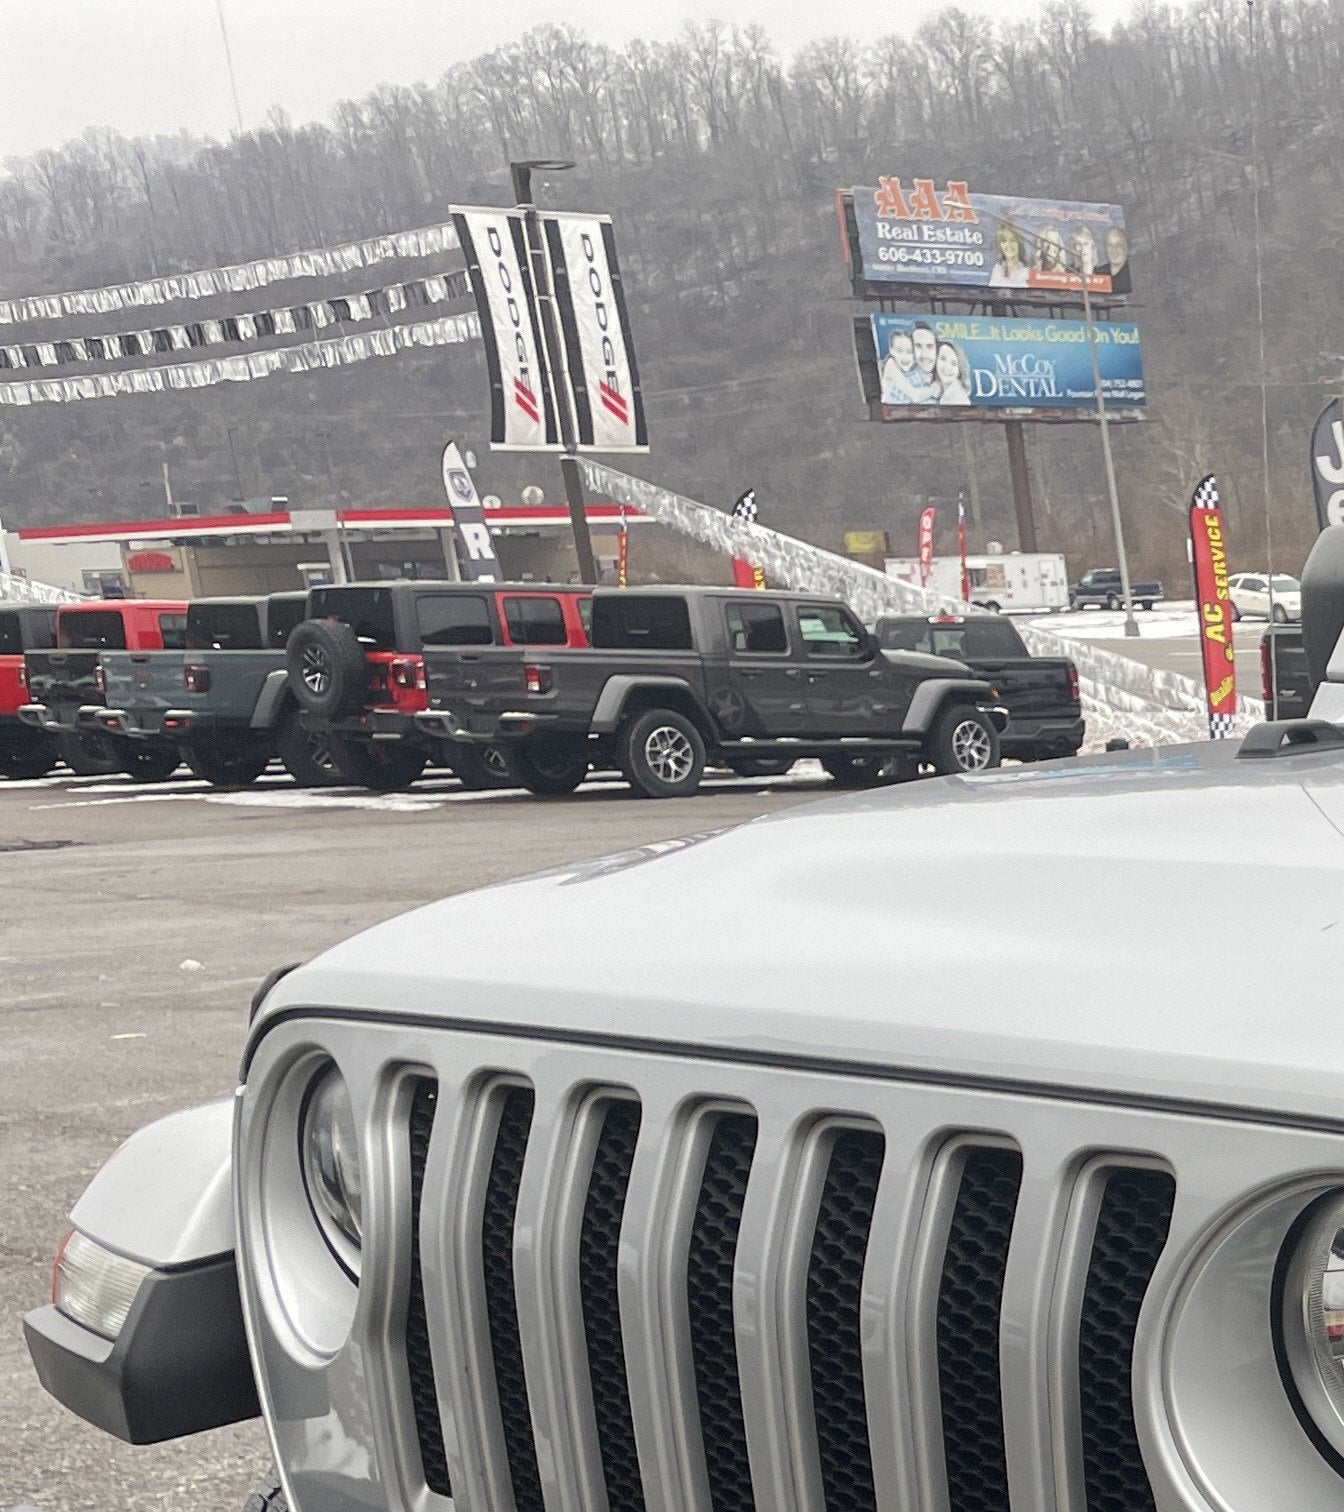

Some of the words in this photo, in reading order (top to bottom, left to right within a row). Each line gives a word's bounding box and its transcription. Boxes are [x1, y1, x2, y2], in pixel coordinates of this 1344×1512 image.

[874, 176, 979, 224] AAA
[876, 222, 919, 240] Real
[922, 225, 983, 245] Estate
[878, 247, 984, 266] 606-433-9700
[487, 227, 531, 391] DODGE
[581, 233, 620, 394] DODGE
[1045, 325, 1085, 343] Good
[973, 369, 1064, 398] DENTAL
[1205, 514, 1229, 601] SERVICE
[1203, 602, 1225, 644] AC
